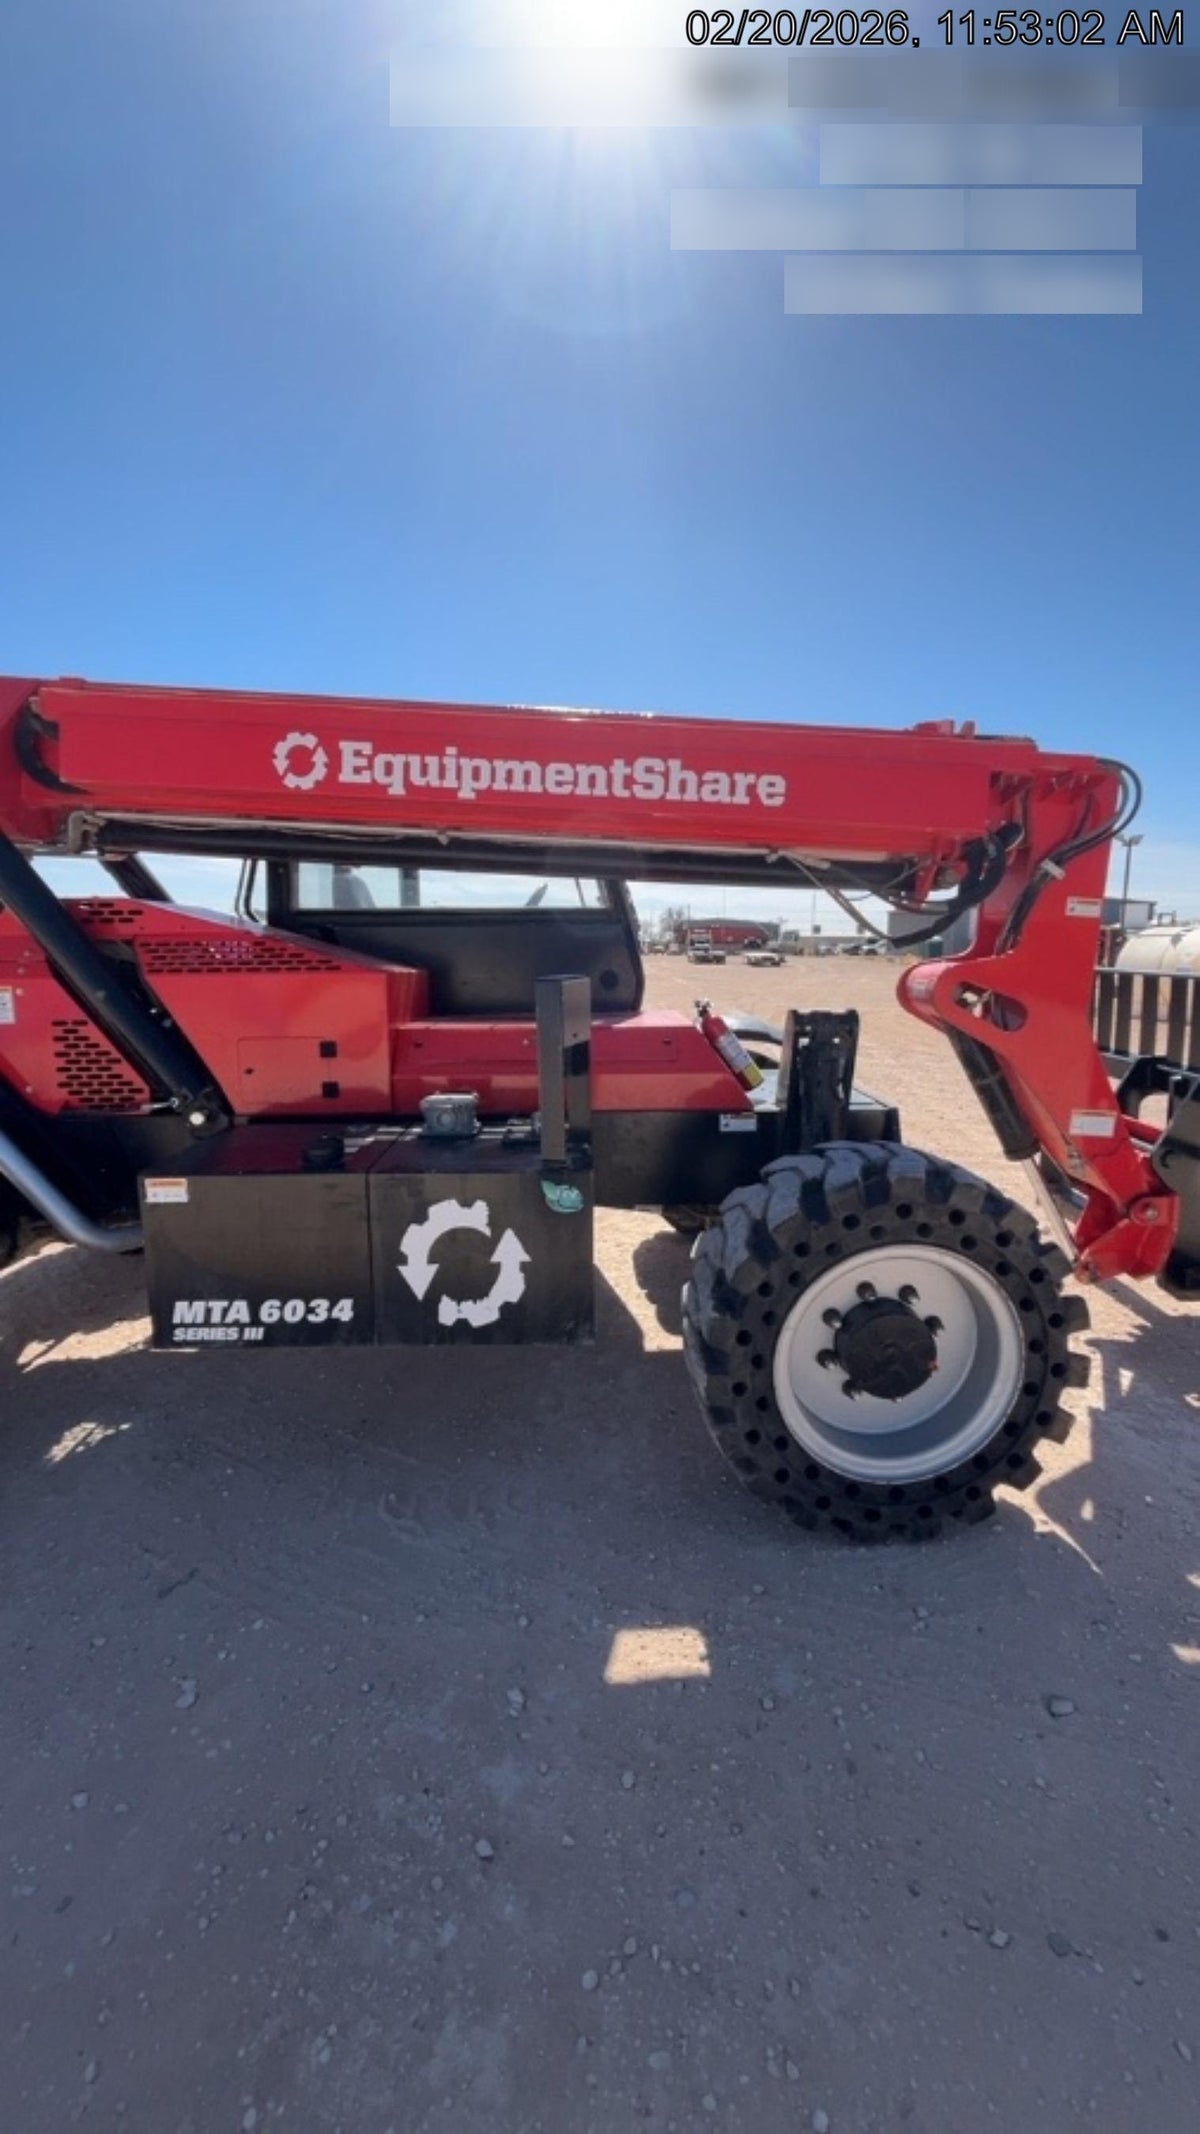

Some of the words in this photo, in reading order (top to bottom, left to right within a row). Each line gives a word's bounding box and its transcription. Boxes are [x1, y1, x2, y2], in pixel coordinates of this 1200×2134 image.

[338, 740, 787, 807] EquipmentShare
[172, 1300, 251, 1324] MTA
[259, 1298, 355, 1323] 6034
[172, 1327, 240, 1341] SERIES
[243, 1327, 265, 1341] III
